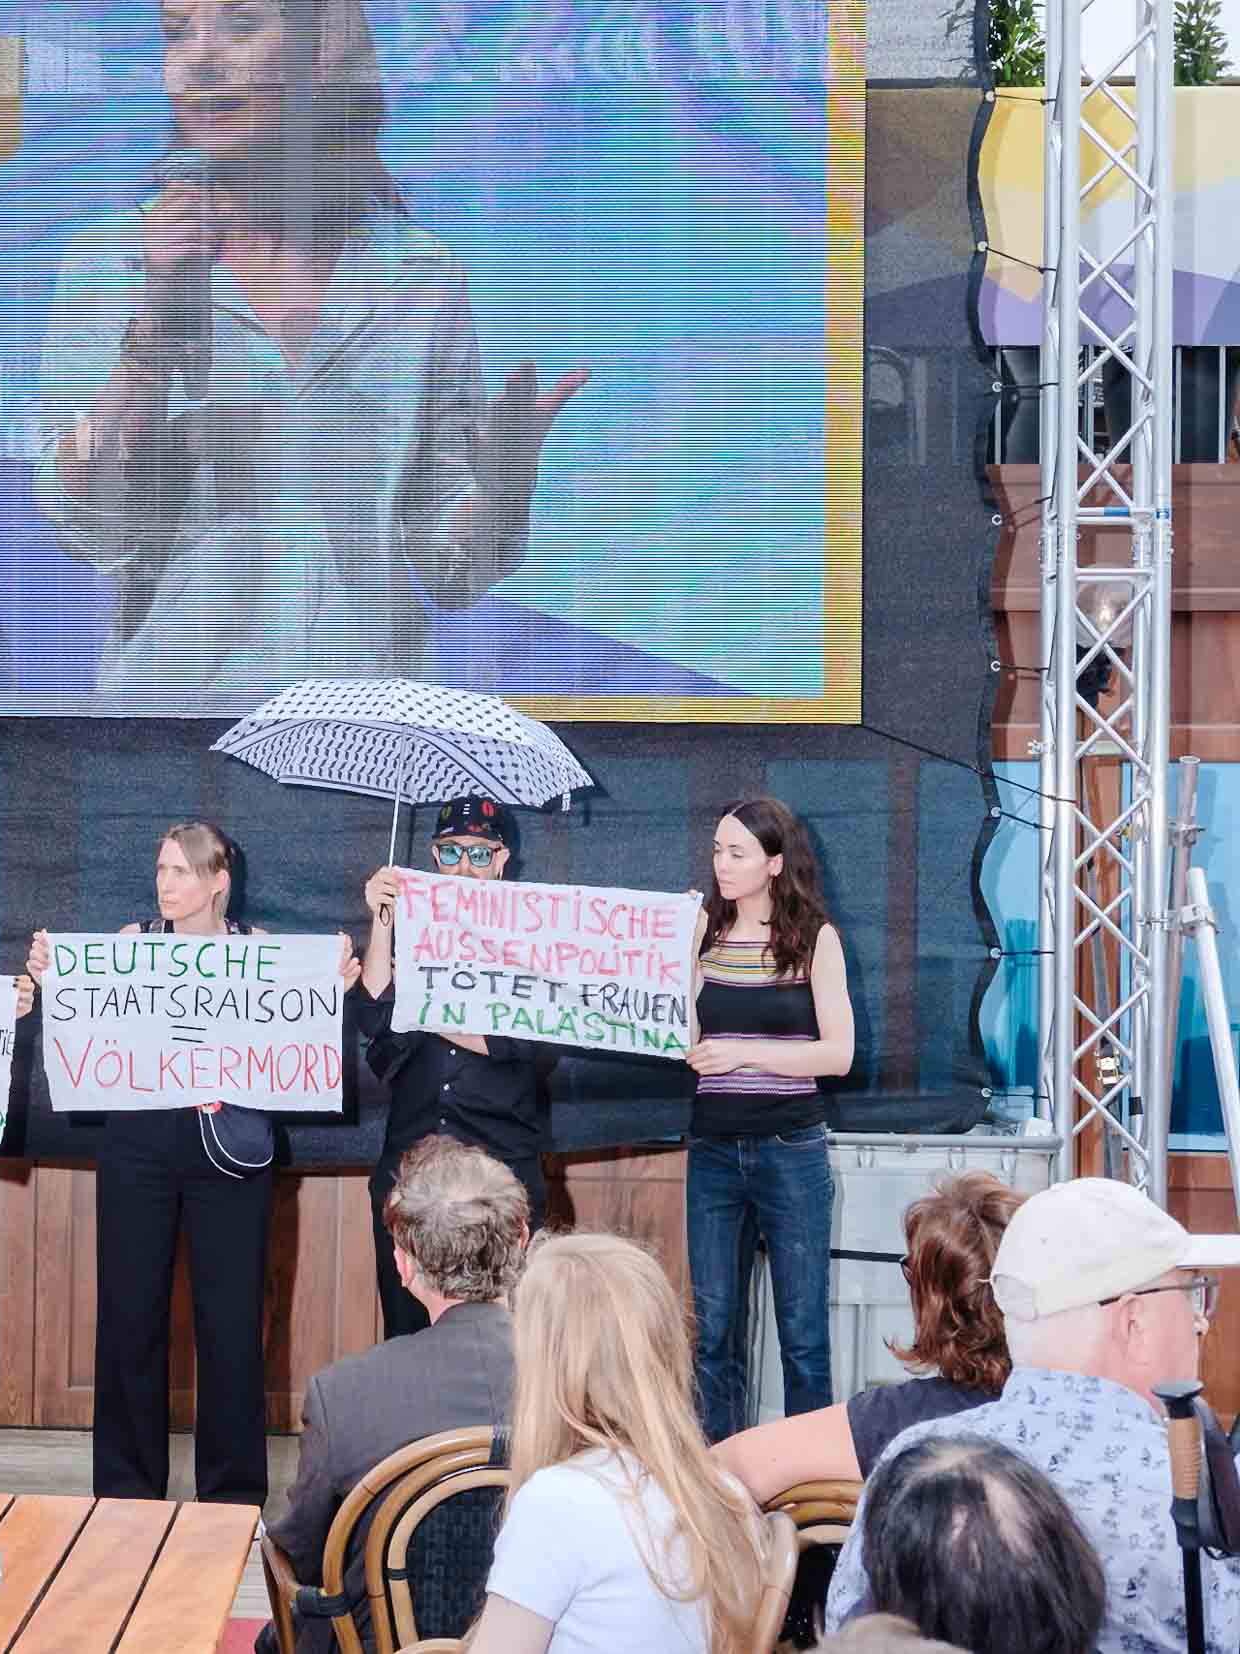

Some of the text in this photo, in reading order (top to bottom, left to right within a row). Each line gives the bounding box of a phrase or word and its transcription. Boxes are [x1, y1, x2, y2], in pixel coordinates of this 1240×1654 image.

[55, 941, 281, 982] DEUTSCHE
[51, 984, 337, 1023] STAATSRAISON
[417, 961, 688, 1027] TÖTET FRAUEN
[488, 1001, 688, 1053] PALÄSTINA
[53, 1035, 342, 1094] VÖLKERMORD
